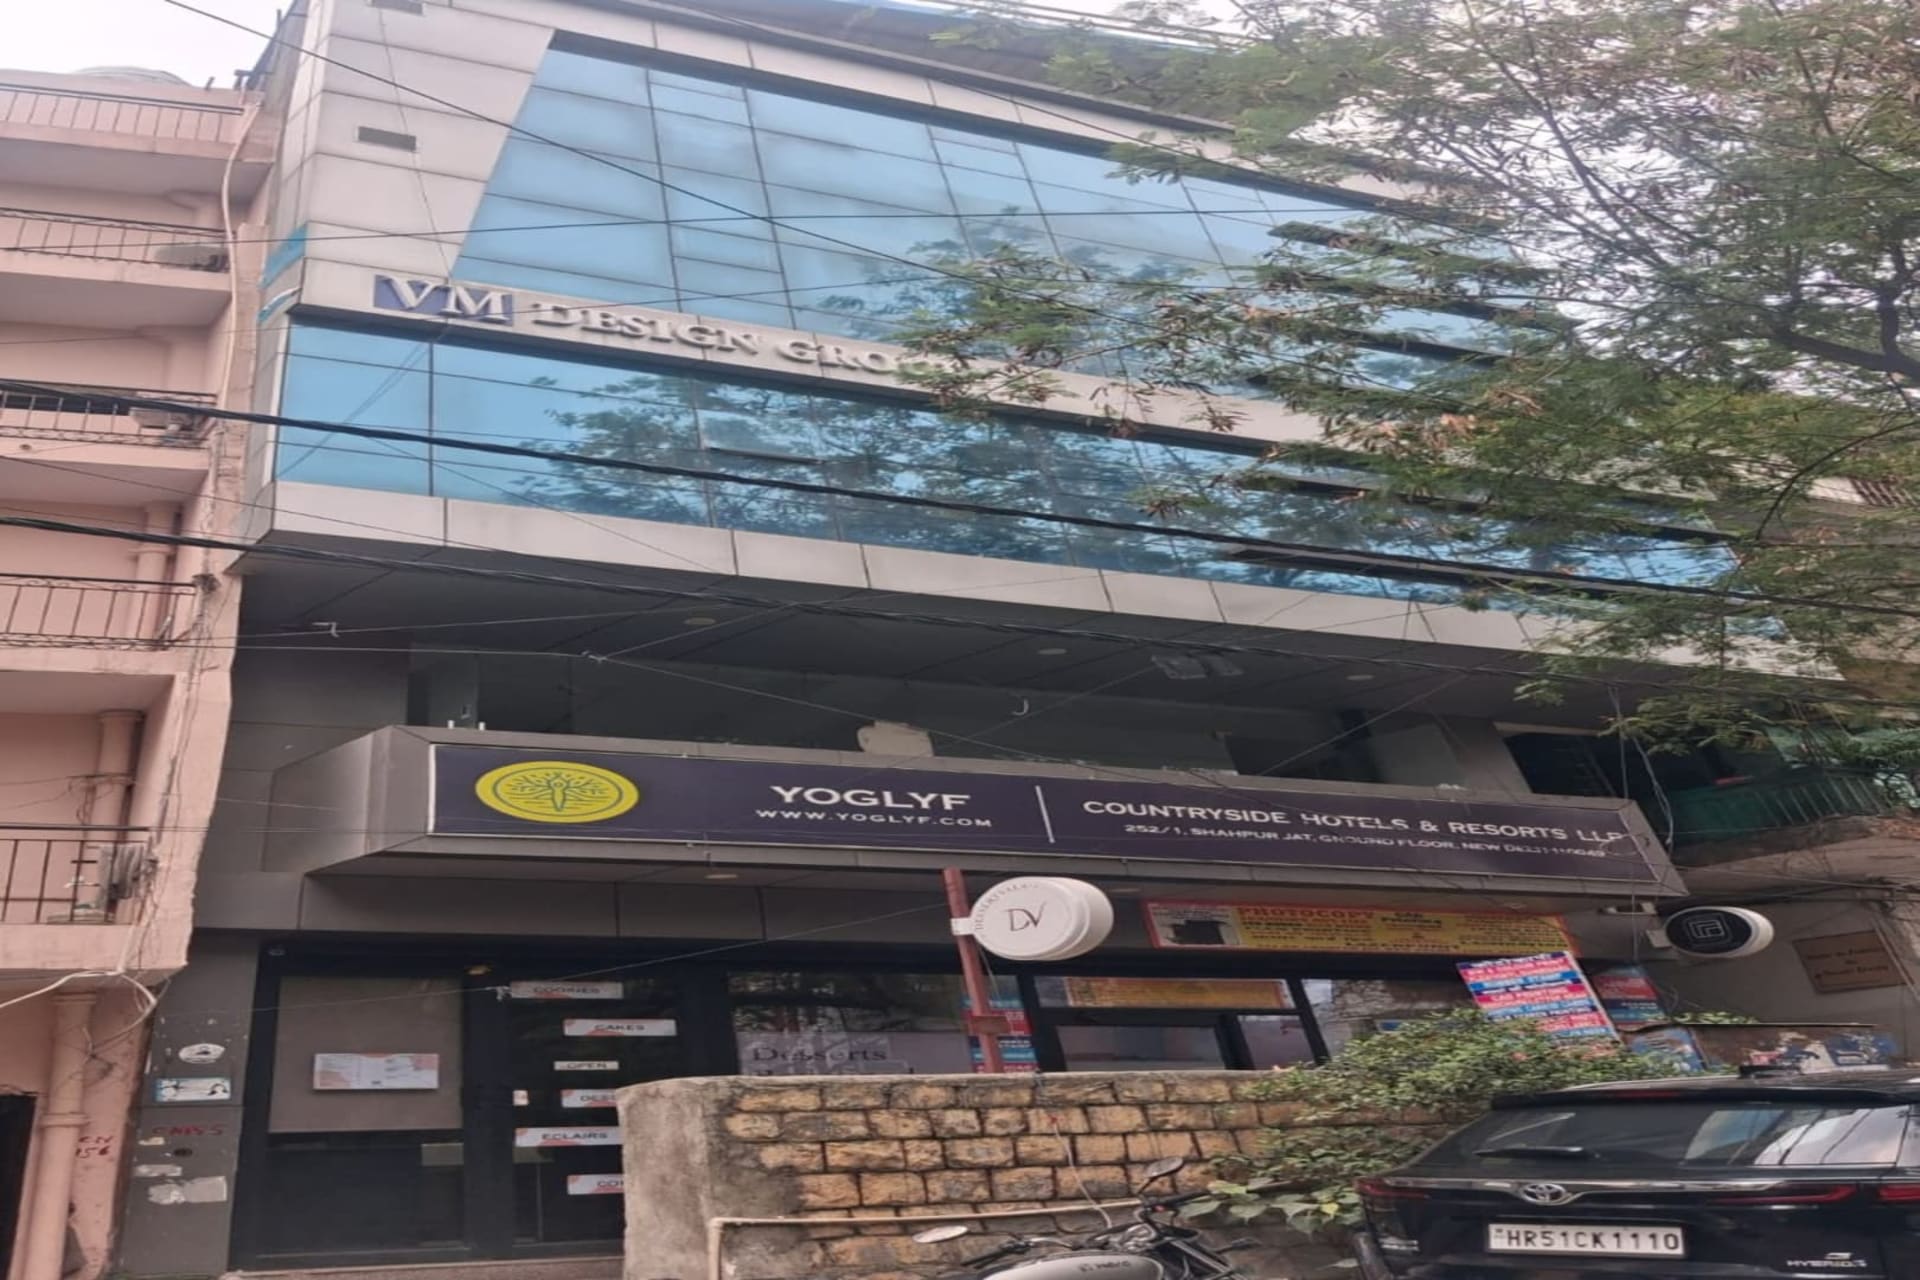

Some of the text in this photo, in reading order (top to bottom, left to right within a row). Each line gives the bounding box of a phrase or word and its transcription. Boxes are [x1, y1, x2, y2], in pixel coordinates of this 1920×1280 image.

[382, 276, 511, 322] VM
[532, 302, 761, 355] DESIGN
[770, 785, 971, 810] YOGLYF
[756, 809, 992, 827] WWW.YOGLYF.COM
[1083, 800, 1291, 824] COUNTRYSIDE
[1300, 812, 1410, 830] HOTELS
[1419, 820, 1438, 833] &
[1448, 821, 1568, 840] RESORTS
[1189, 827, 1280, 841] SHAHPUR
[1506, 1229, 1679, 1251] HR51CK1110
